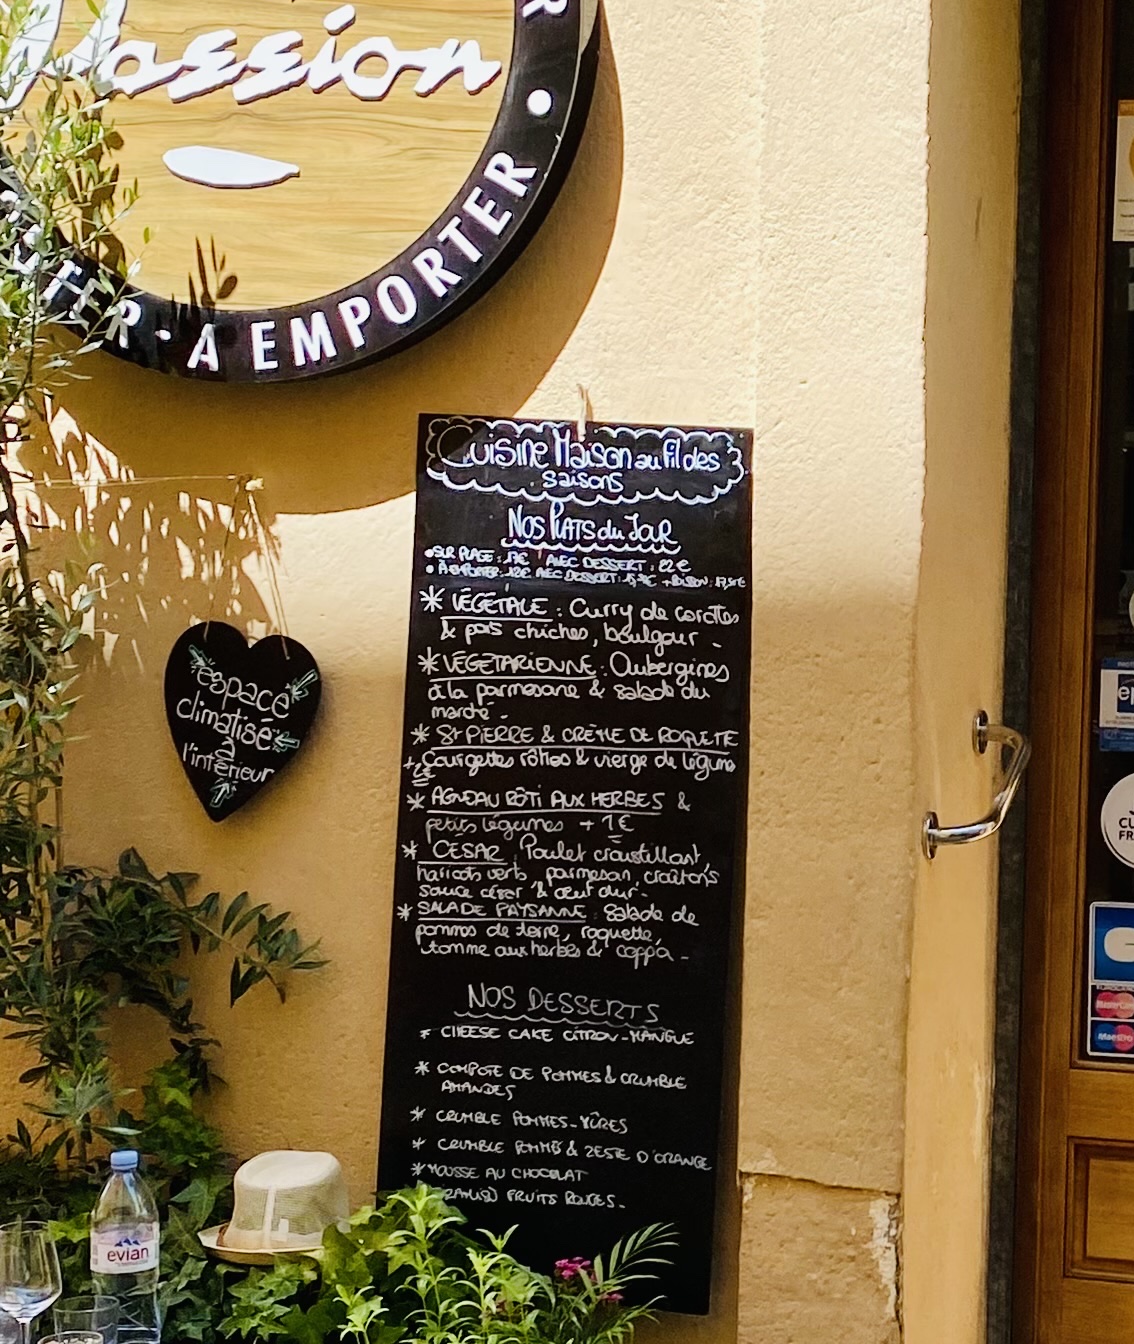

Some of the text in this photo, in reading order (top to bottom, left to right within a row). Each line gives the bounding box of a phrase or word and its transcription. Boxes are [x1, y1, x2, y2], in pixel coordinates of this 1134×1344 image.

[251, 150, 538, 372] EMPORTER
[439, 424, 548, 468] Cuisine
[555, 427, 632, 470] Maison
[636, 454, 661, 470] au
[683, 441, 721, 472] des
[542, 470, 625, 493] saisons
[597, 517, 624, 540] du
[569, 597, 634, 633] Curry
[640, 601, 668, 621] de
[464, 622, 503, 645] pois
[604, 622, 699, 655] boulgour
[609, 650, 730, 686] Aubergines
[197, 666, 290, 719] espace
[681, 680, 711, 701] du
[176, 690, 274, 751] climatisé
[182, 742, 275, 783] l'intérieur
[594, 752, 648, 775] vierge
[654, 750, 678, 770] de
[431, 786, 500, 809] AGNEAU
[551, 790, 586, 808] AUX
[590, 790, 665, 810] HERBES
[519, 832, 585, 864] Poulet
[416, 864, 482, 882] haricots
[418, 884, 473, 899] sauce
[417, 903, 488, 917] SALADE
[495, 903, 587, 920] PAYSANNE
[671, 905, 700, 926] de
[485, 921, 511, 938] de
[420, 939, 488, 957] tomme
[494, 943, 528, 958] aux
[530, 939, 582, 958] herbes
[616, 944, 674, 969] coppa
[468, 982, 661, 1023] NOS DESSERTS
[440, 1025, 501, 1039] CHEESE
[508, 1028, 553, 1043] CAKE
[436, 1062, 503, 1079] COMPOTE
[509, 1066, 534, 1081] DE
[541, 1067, 602, 1084] POMMES
[619, 1072, 687, 1090] CRUMBLE
[440, 1080, 516, 1101] AMANDES
[435, 1109, 501, 1126] CRUMBLE
[437, 1137, 505, 1154] CRUMBLE
[428, 1163, 589, 1182] MOUSSE AU CHOCOLAT
[107, 1247, 149, 1262] evian
